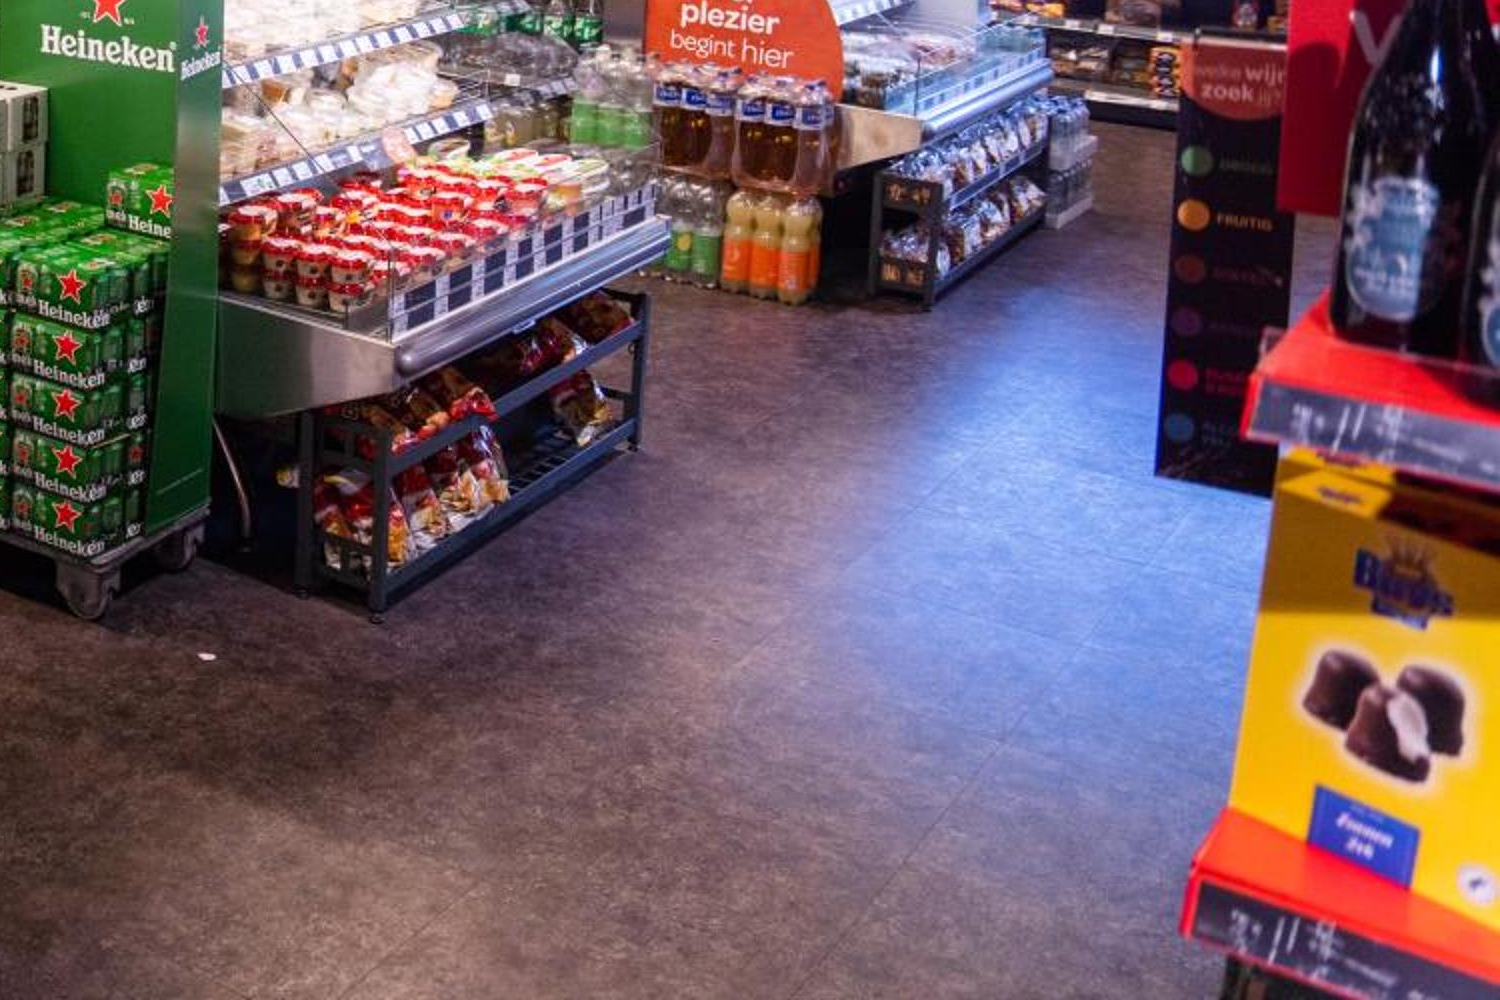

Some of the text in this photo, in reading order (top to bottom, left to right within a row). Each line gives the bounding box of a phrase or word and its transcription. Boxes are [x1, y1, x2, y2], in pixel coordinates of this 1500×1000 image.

[680, 0, 781, 35] plezier
[40, 23, 176, 73] Heineken
[670, 28, 794, 68] begint hier
[180, 50, 222, 81] Heineken
[1202, 84, 1254, 103] zoek
[128, 213, 173, 239] Heine
[38, 299, 112, 330] Heineken
[33, 359, 106, 390] Heineken
[32, 414, 105, 448] Heineken
[34, 471, 107, 502] Heineken
[34, 526, 106, 557] Heineken
